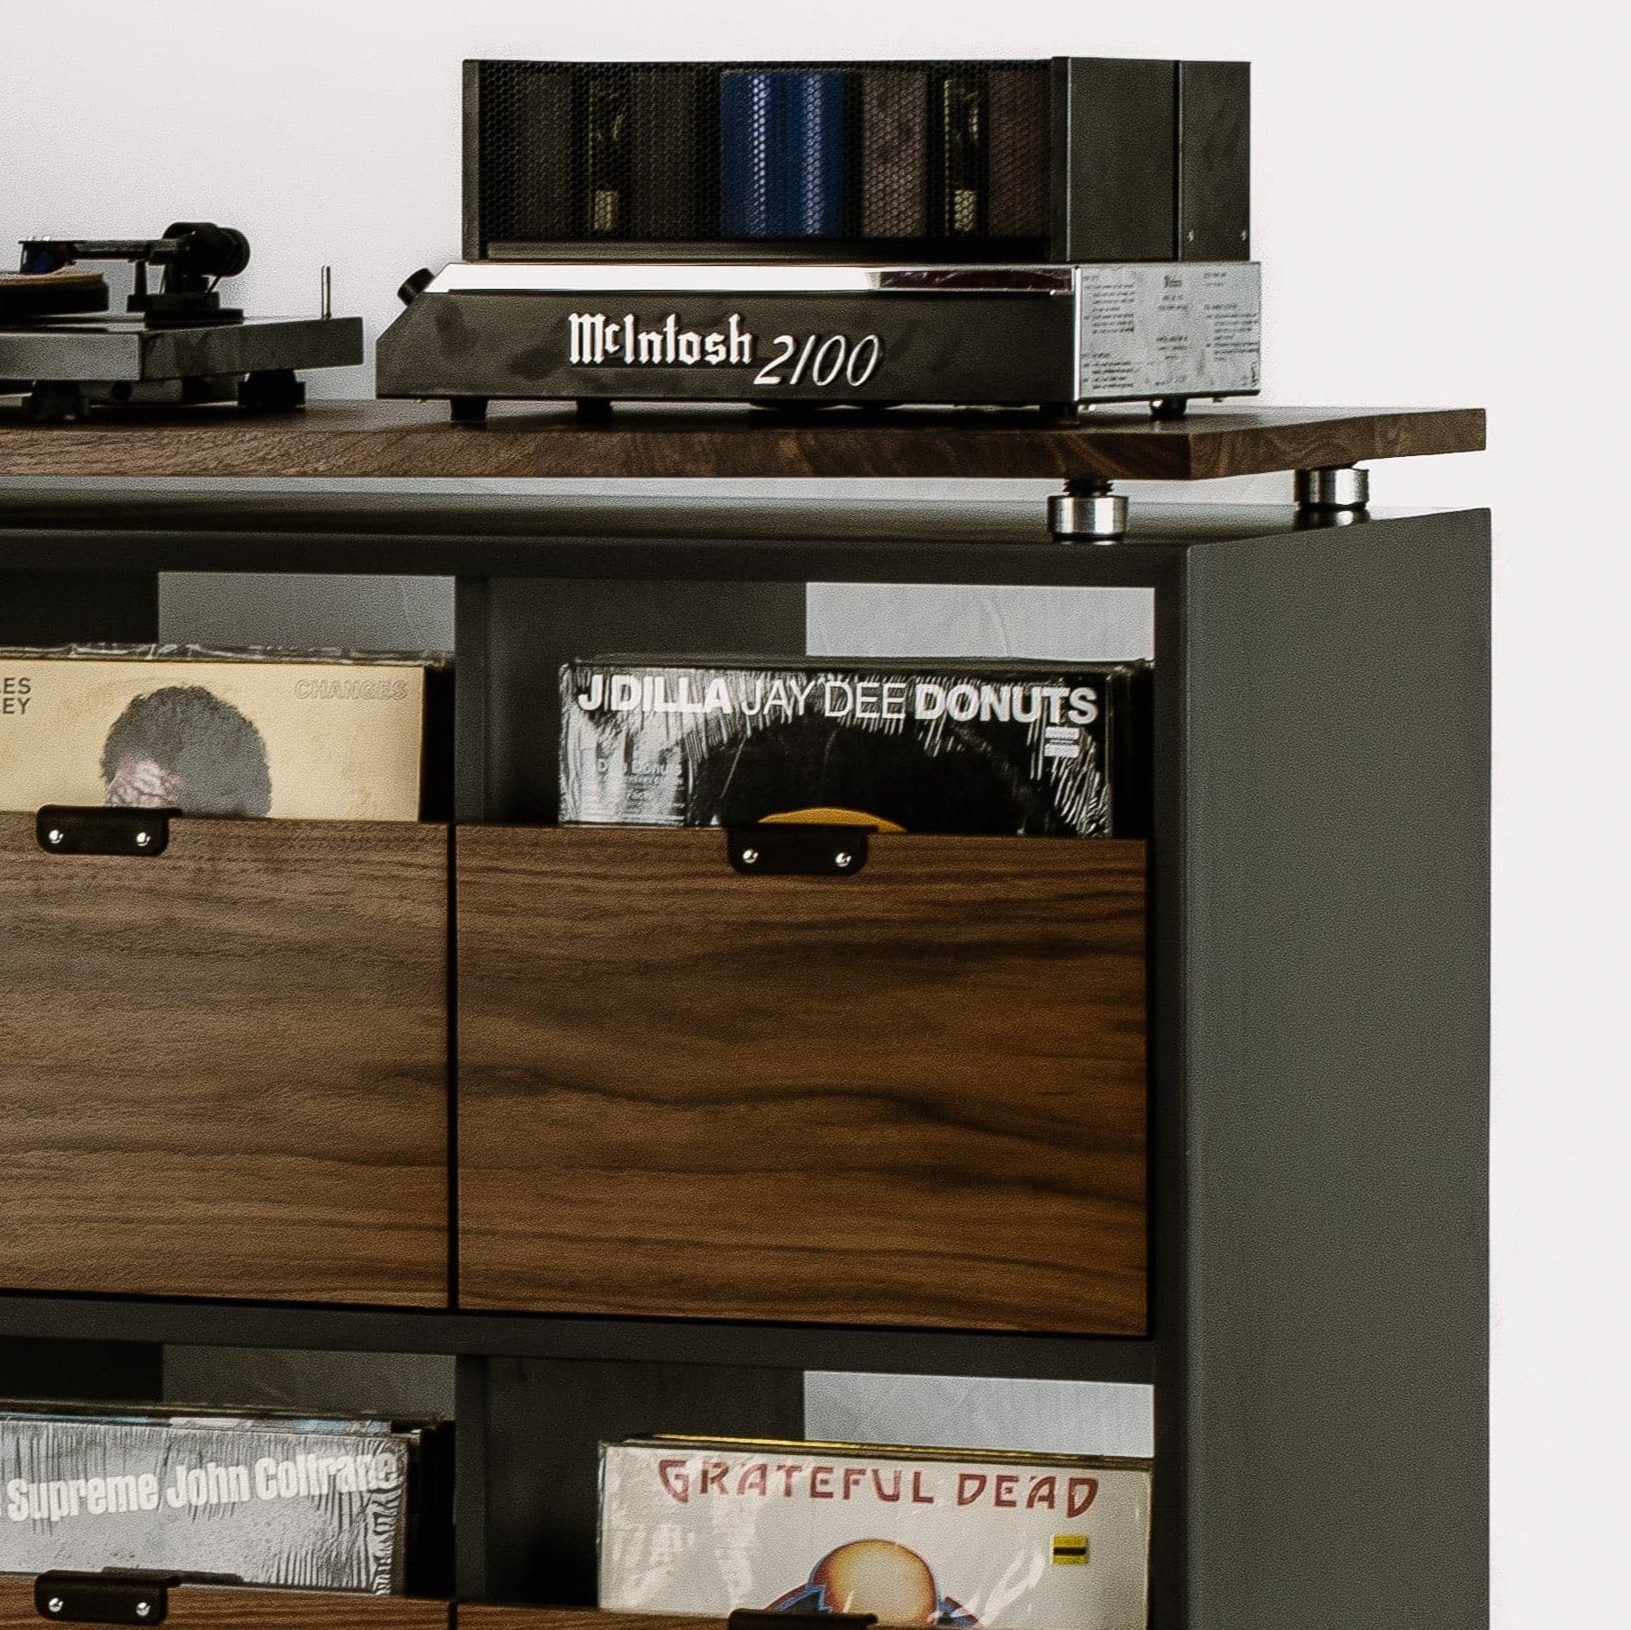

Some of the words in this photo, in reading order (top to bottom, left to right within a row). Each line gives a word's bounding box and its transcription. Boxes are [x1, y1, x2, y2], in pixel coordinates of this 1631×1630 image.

[568, 313, 753, 365] McIntosh
[753, 334, 880, 387] 2100
[294, 678, 409, 701] CHANGES
[741, 679, 815, 717] JAY
[824, 682, 906, 719] DEE
[915, 684, 1099, 725] DONUTS
[7, 1473, 159, 1524] Supreme
[167, 1461, 250, 1508] John
[255, 1449, 401, 1500] Coltrane
[658, 1459, 935, 1505] GRATEFUL
[956, 1473, 1100, 1519] DEAD
